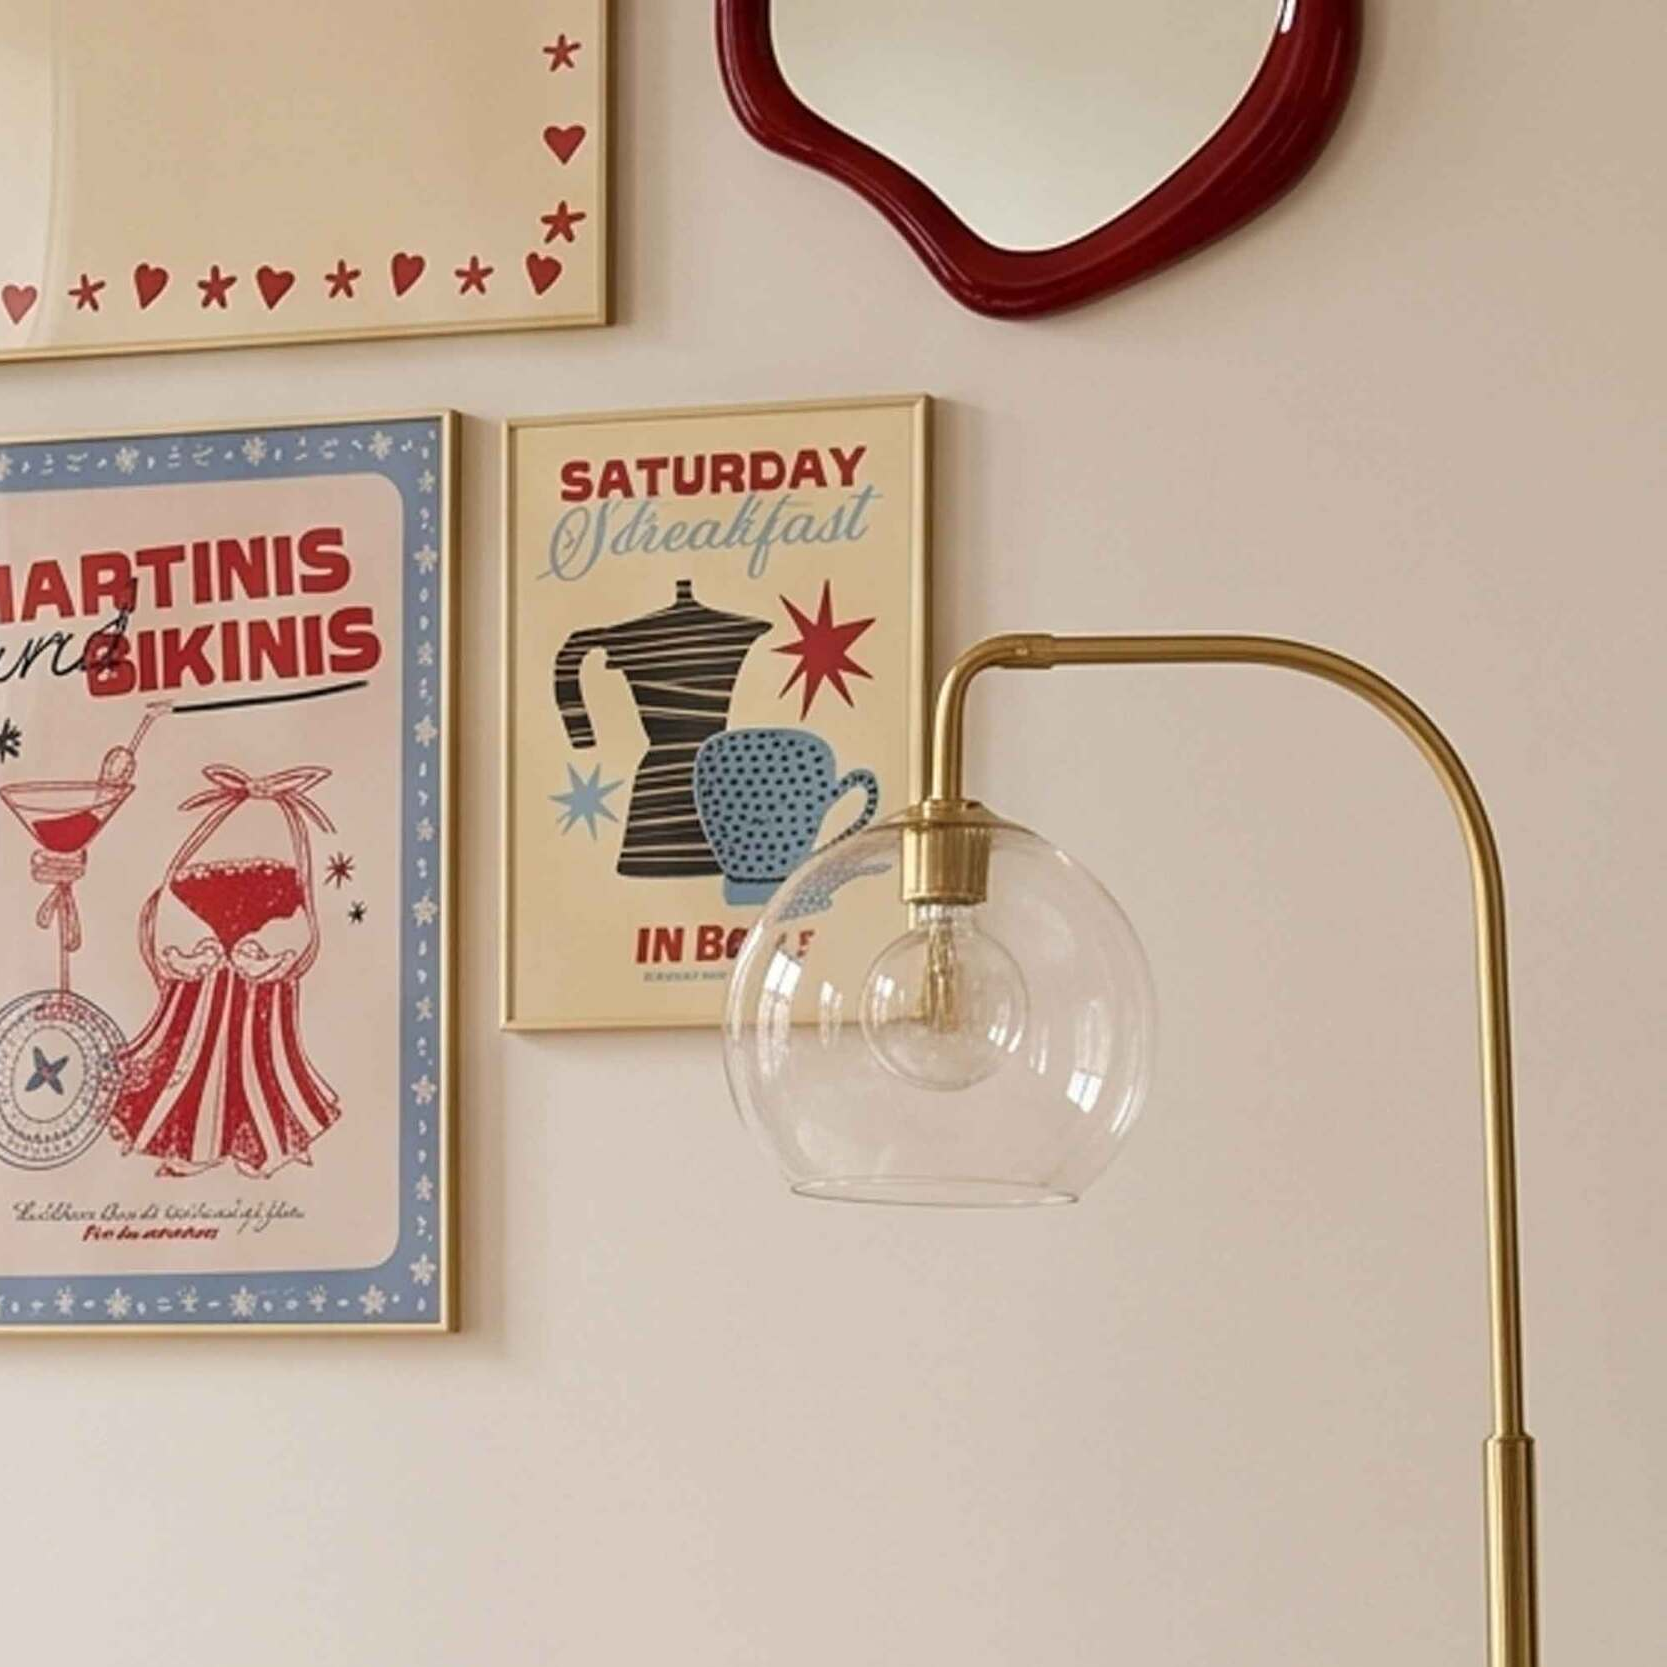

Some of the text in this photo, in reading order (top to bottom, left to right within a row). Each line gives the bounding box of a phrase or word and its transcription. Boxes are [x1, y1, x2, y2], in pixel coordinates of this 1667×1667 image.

[560, 446, 866, 502] SATURDAY
[84, 606, 383, 697] BIKINIS
[635, 927, 685, 964] IN
